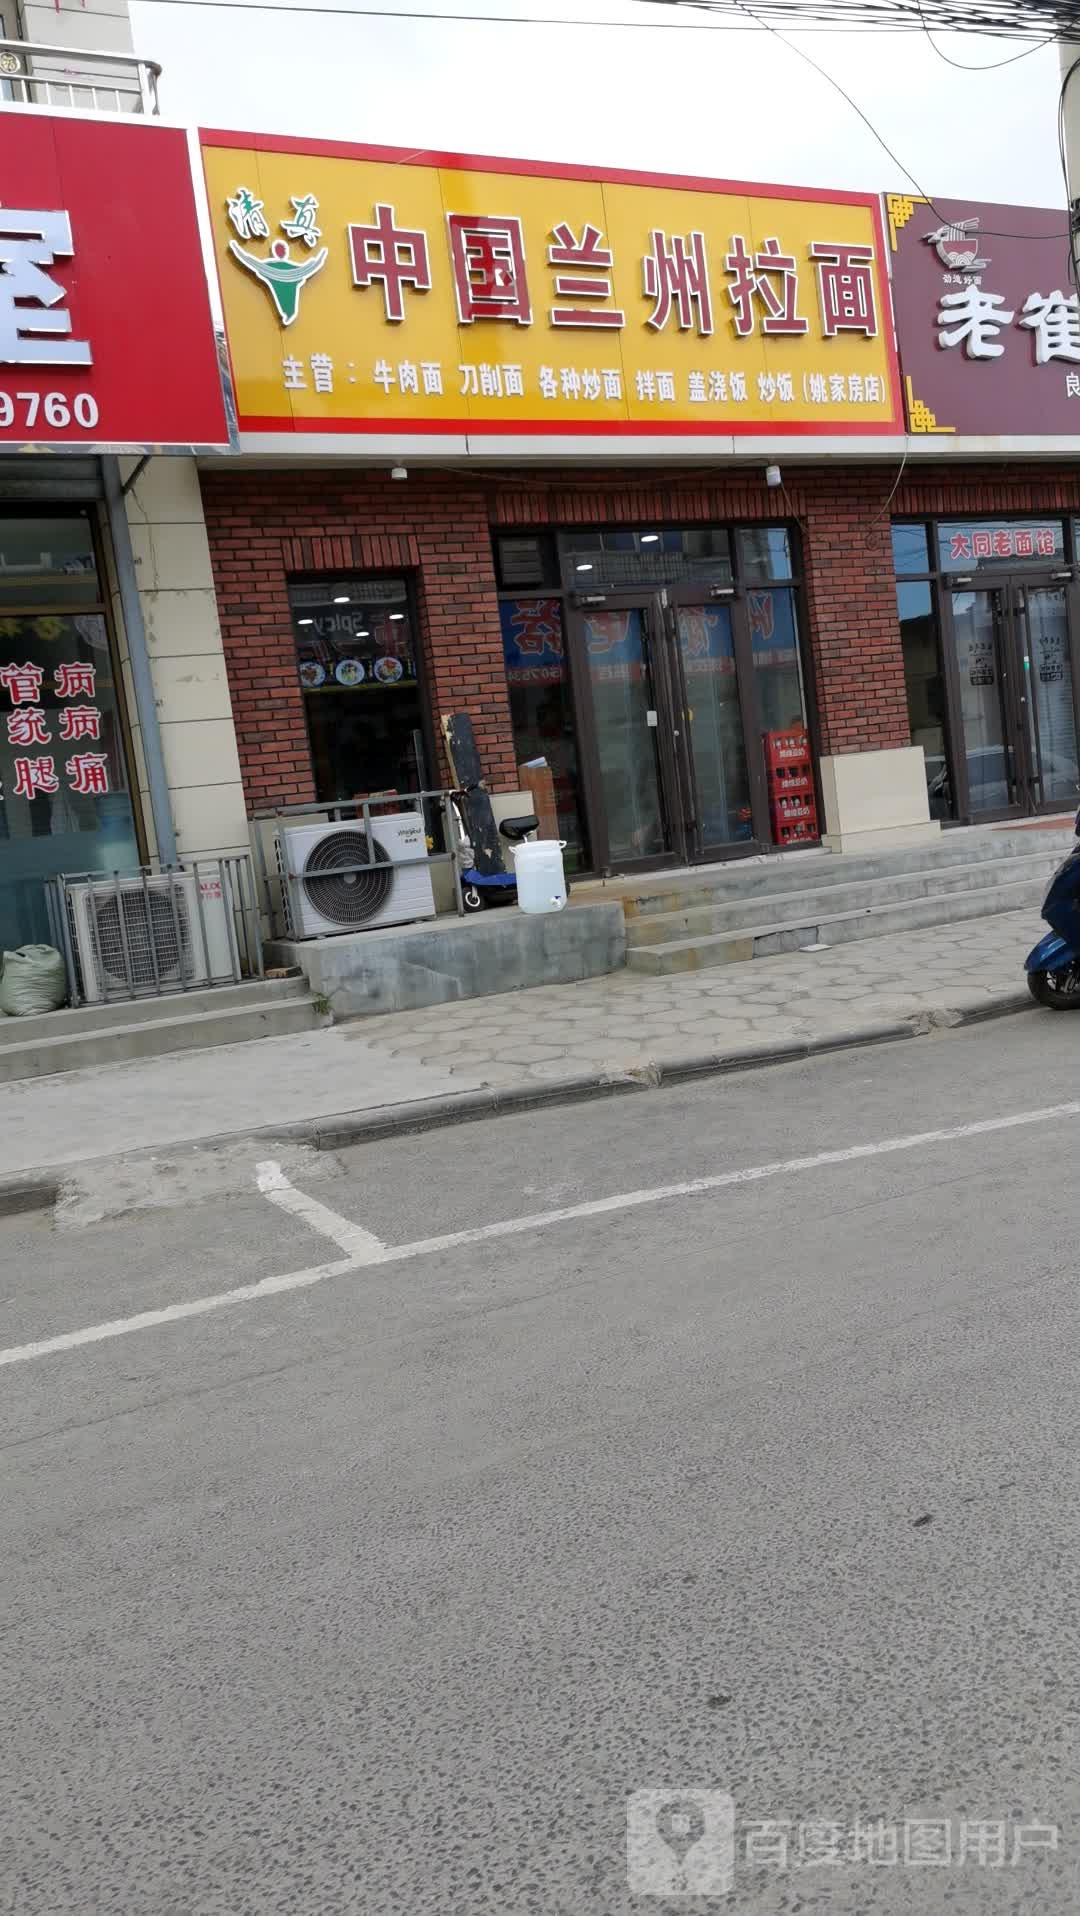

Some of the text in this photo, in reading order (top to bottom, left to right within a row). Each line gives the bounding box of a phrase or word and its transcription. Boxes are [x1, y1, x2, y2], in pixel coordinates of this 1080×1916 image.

[226, 187, 322, 247] 清真
[347, 203, 880, 338] 中国兰州拉面
[373, 359, 444, 396] 牛肉面
[458, 363, 524, 398] 刀削面
[539, 364, 623, 400] 各种炒面
[635, 370, 676, 401] 拌面
[688, 370, 748, 402] 盖浇饭
[950, 528, 1056, 560] 大同老面馆
[0, 753, 108, 800] 腿痛
